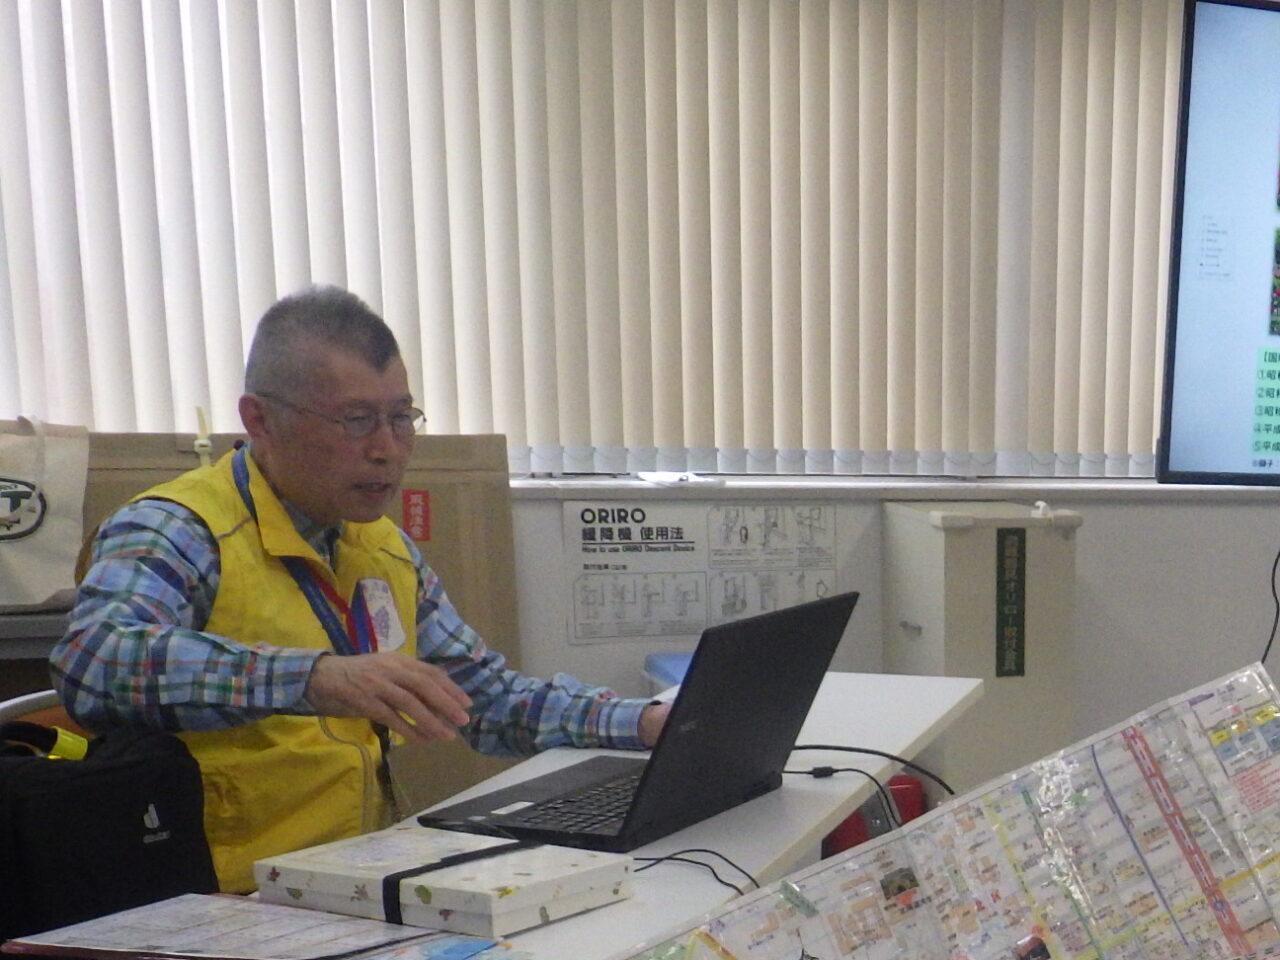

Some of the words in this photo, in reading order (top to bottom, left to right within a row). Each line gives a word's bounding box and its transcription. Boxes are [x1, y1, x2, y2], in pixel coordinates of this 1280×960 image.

[581, 508, 646, 524] ORIRO
[640, 526, 684, 540] 使用法
